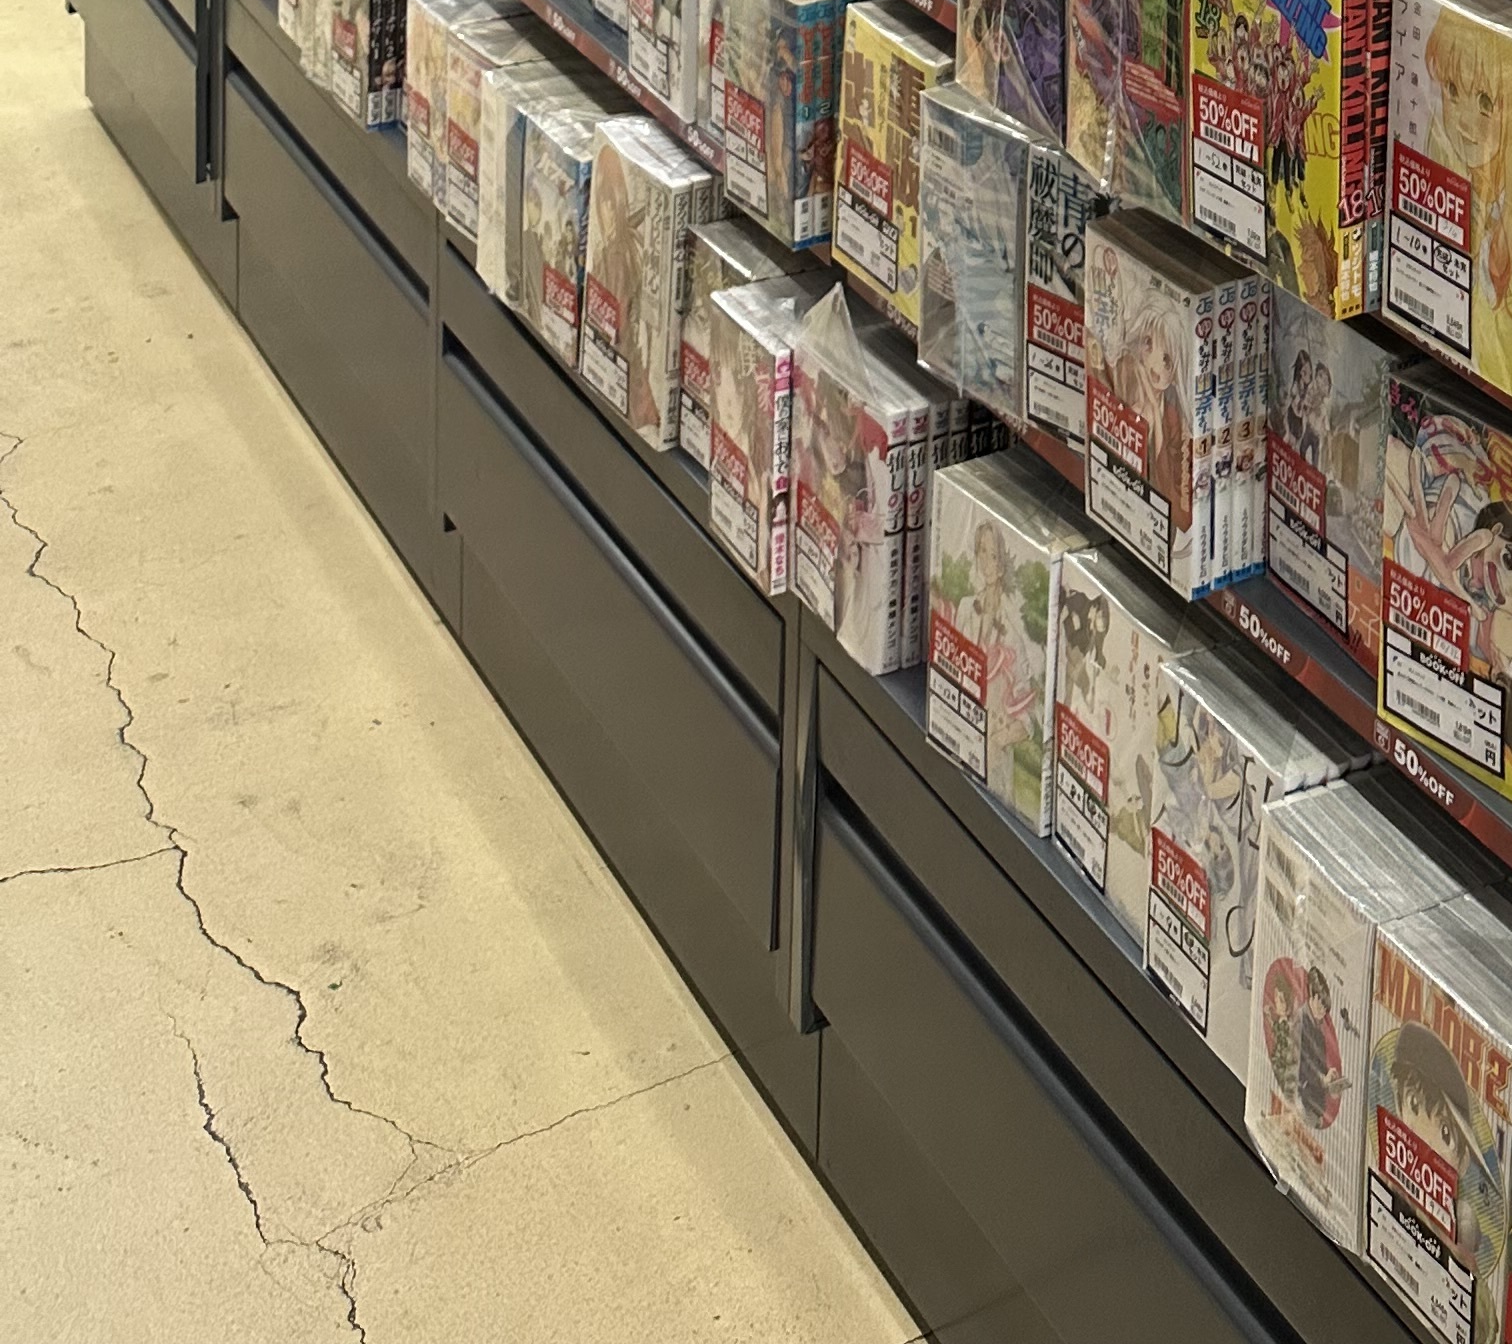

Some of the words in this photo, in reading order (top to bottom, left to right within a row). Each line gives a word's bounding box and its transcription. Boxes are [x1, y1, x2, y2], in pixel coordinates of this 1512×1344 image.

[1199, 95, 1258, 141] 50%OFF
[1398, 171, 1465, 222] 50%OFF
[1388, 588, 1464, 645] 50%OFF
[1393, 740, 1456, 807] 50%OFF
